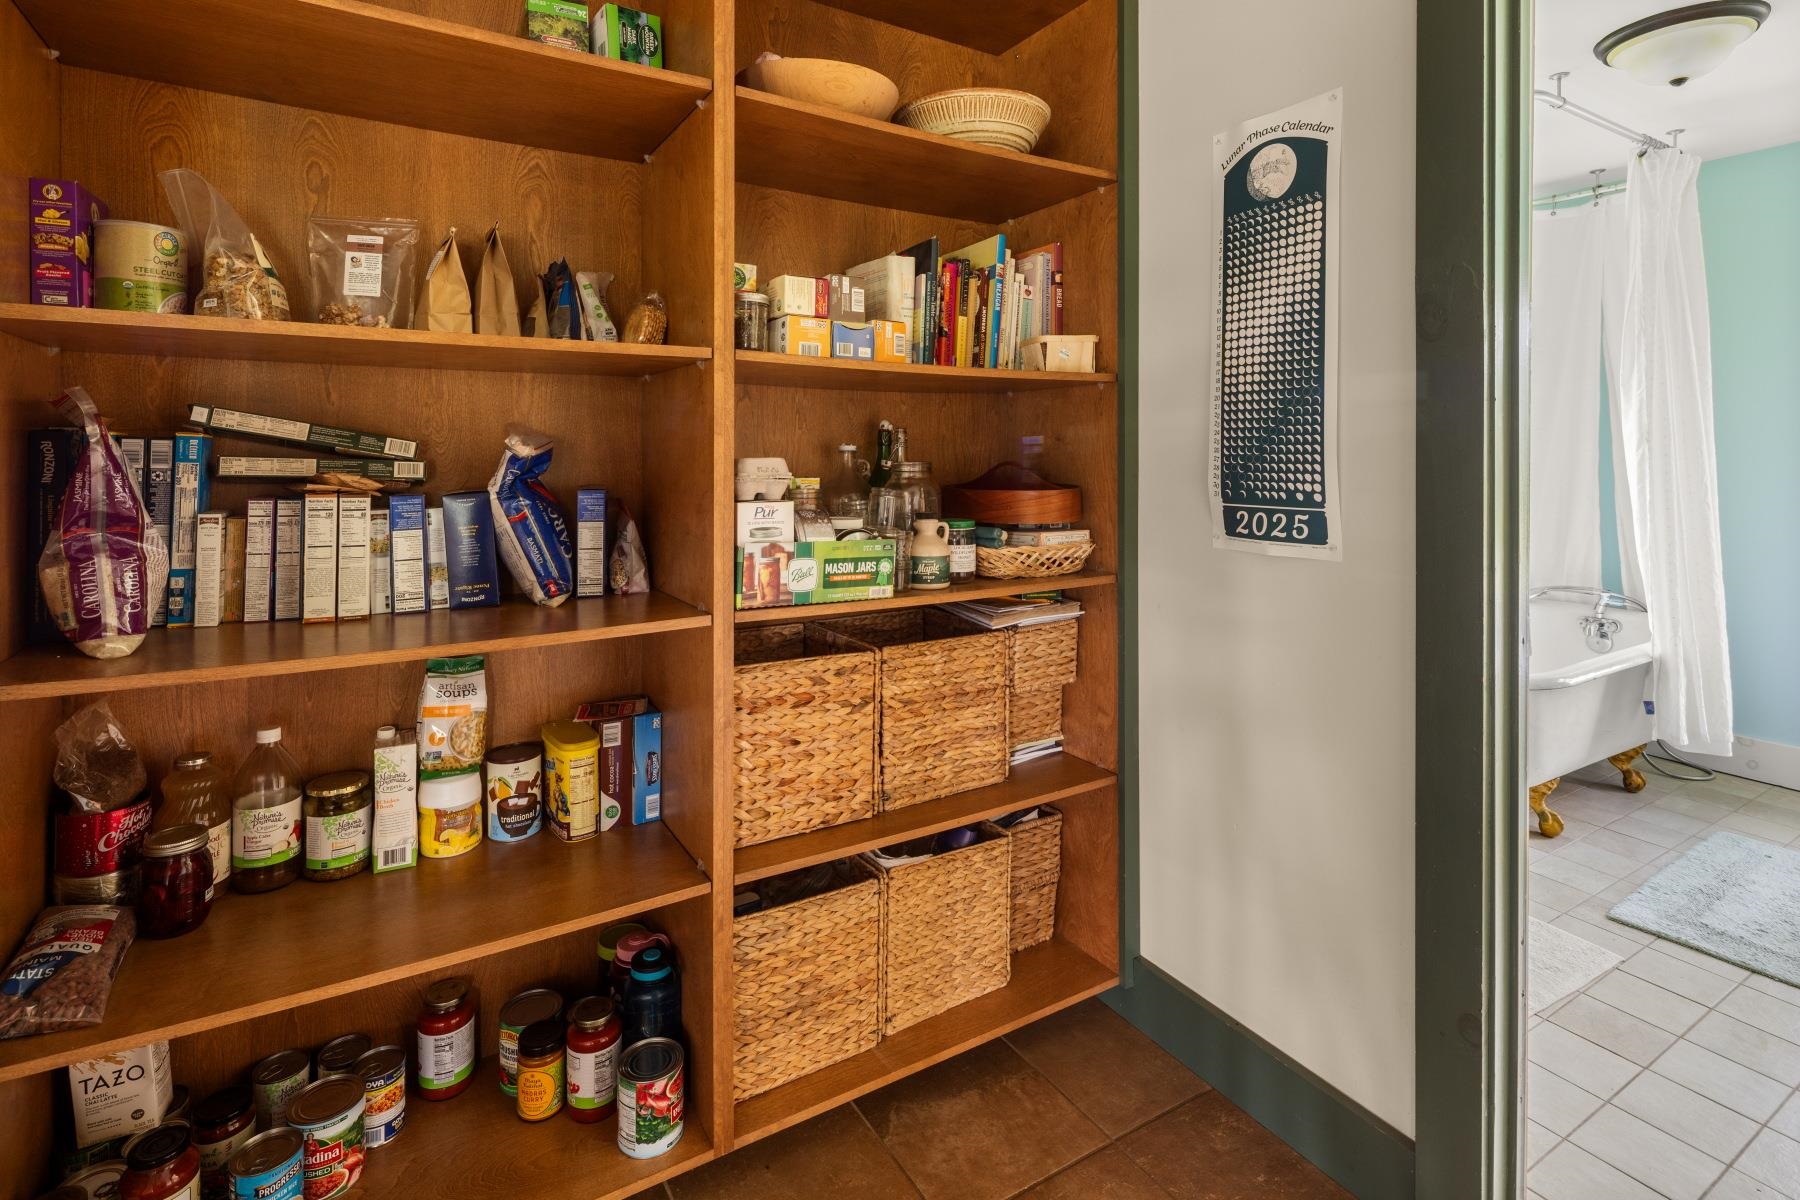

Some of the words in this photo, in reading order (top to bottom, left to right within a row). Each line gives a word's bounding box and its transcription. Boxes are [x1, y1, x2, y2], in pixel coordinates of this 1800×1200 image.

[1221, 142, 1245, 171] Lunar
[1247, 124, 1280, 143] Phase
[1281, 120, 1334, 134] Calendar
[40, 440, 55, 483] RONZONI
[73, 472, 83, 502] JASMINE
[754, 506, 779, 518] Pur
[1235, 510, 1309, 539] 2025
[791, 566, 815, 583] Ball
[825, 562, 854, 574] MASON
[856, 561, 877, 573] JARS
[914, 563, 940, 576] Maple
[80, 557, 101, 619] CAROLINA
[435, 688, 478, 698] soups
[438, 680, 475, 690] artisan
[119, 808, 145, 831] Hot
[501, 809, 535, 823] traditional
[78, 1064, 145, 1095] TAZO
[365, 1079, 385, 1089] OYA
[84, 1091, 109, 1102] CLASSIC
[304, 1147, 340, 1165] adina
[258, 1160, 303, 1198] PROGRESSO
